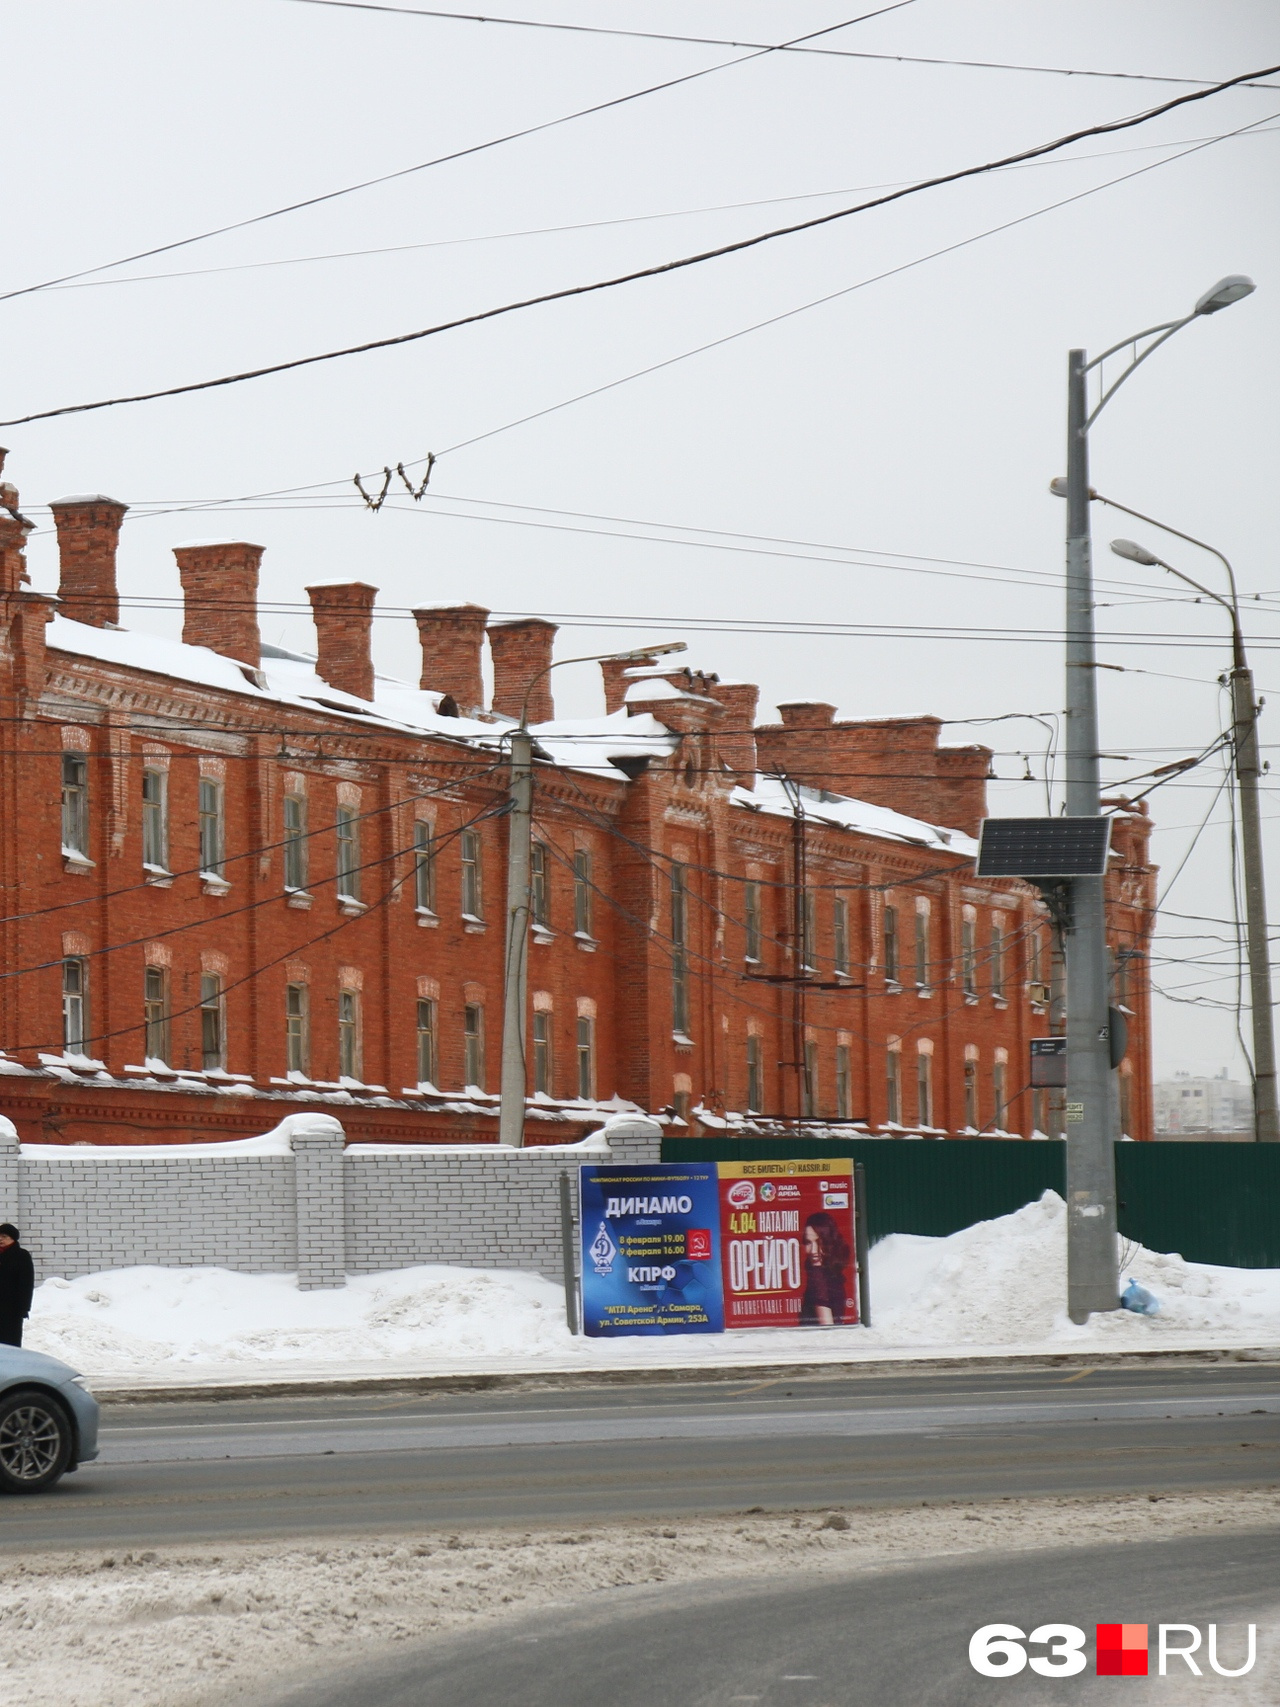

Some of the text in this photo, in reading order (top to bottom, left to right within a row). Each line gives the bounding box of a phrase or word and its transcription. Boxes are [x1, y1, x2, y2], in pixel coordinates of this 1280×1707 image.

[743, 1163, 831, 1174] ВСЕ БИЛЕТЫ KASSIR.RU
[829, 1181, 848, 1189] music
[605, 1195, 693, 1218] ДИНАМО
[730, 1210, 799, 1234] 4.04 НАТАЛИЯ
[619, 1234, 685, 1245] 8 февраля 19.00
[619, 1248, 625, 1256] 9
[626, 1248, 661, 1258] февраля
[663, 1246, 685, 1255] 16.00
[729, 1235, 801, 1291] ОРЕЙРО
[628, 1265, 676, 1282] КПРФ
[669, 1303, 703, 1313] Самара,
[732, 1298, 802, 1316] UNFORGETTABLE TOUR
[599, 1320, 612, 1328] ул.
[614, 1317, 655, 1326] Советской
[657, 1316, 686, 1325] Армии,
